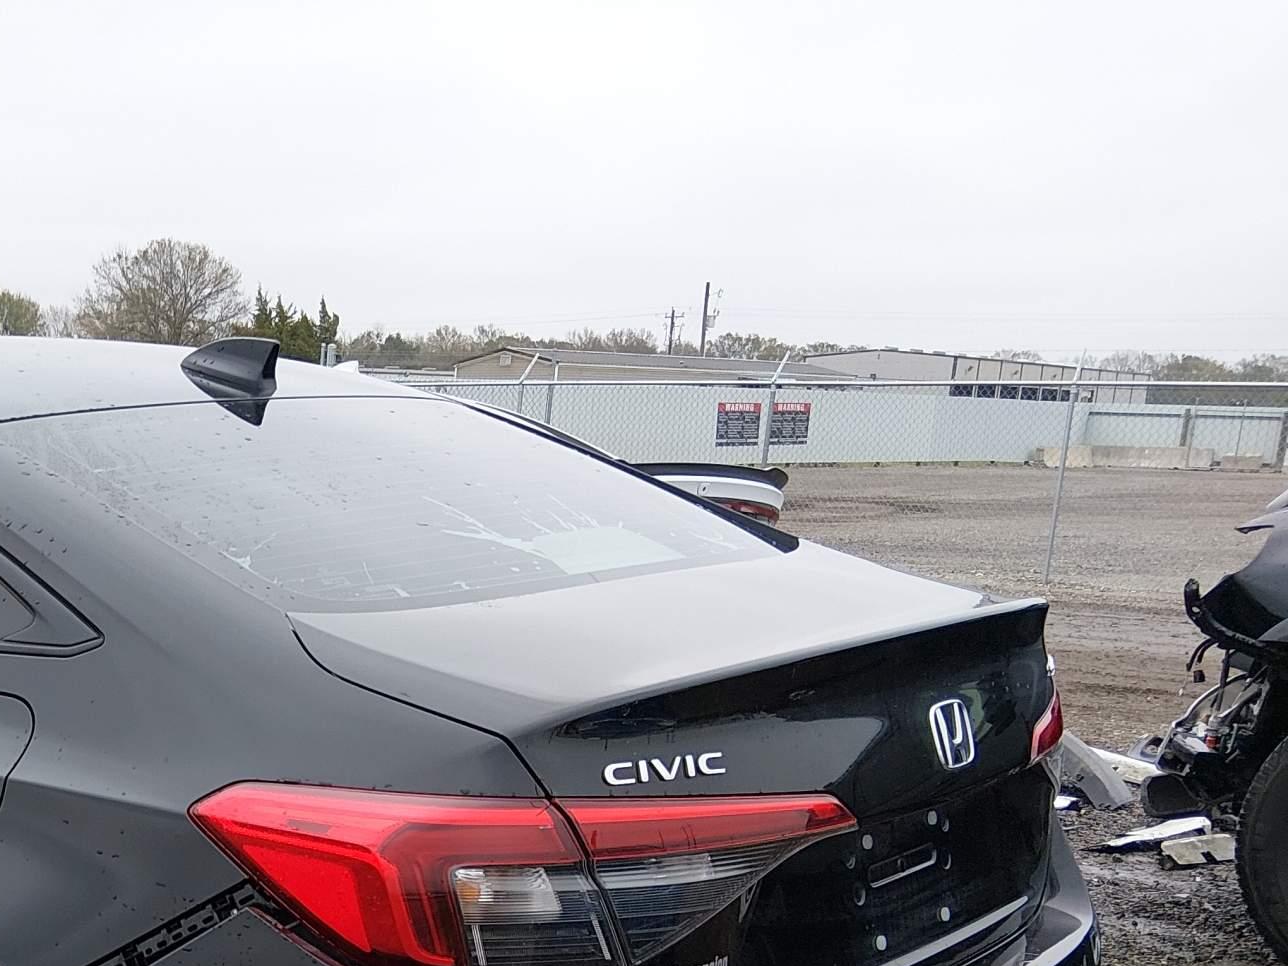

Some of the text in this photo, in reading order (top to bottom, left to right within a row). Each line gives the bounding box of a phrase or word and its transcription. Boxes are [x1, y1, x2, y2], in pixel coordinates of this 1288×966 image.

[725, 403, 754, 411] WARNING
[777, 403, 805, 411] WARNING
[603, 751, 727, 786] CIVIC
